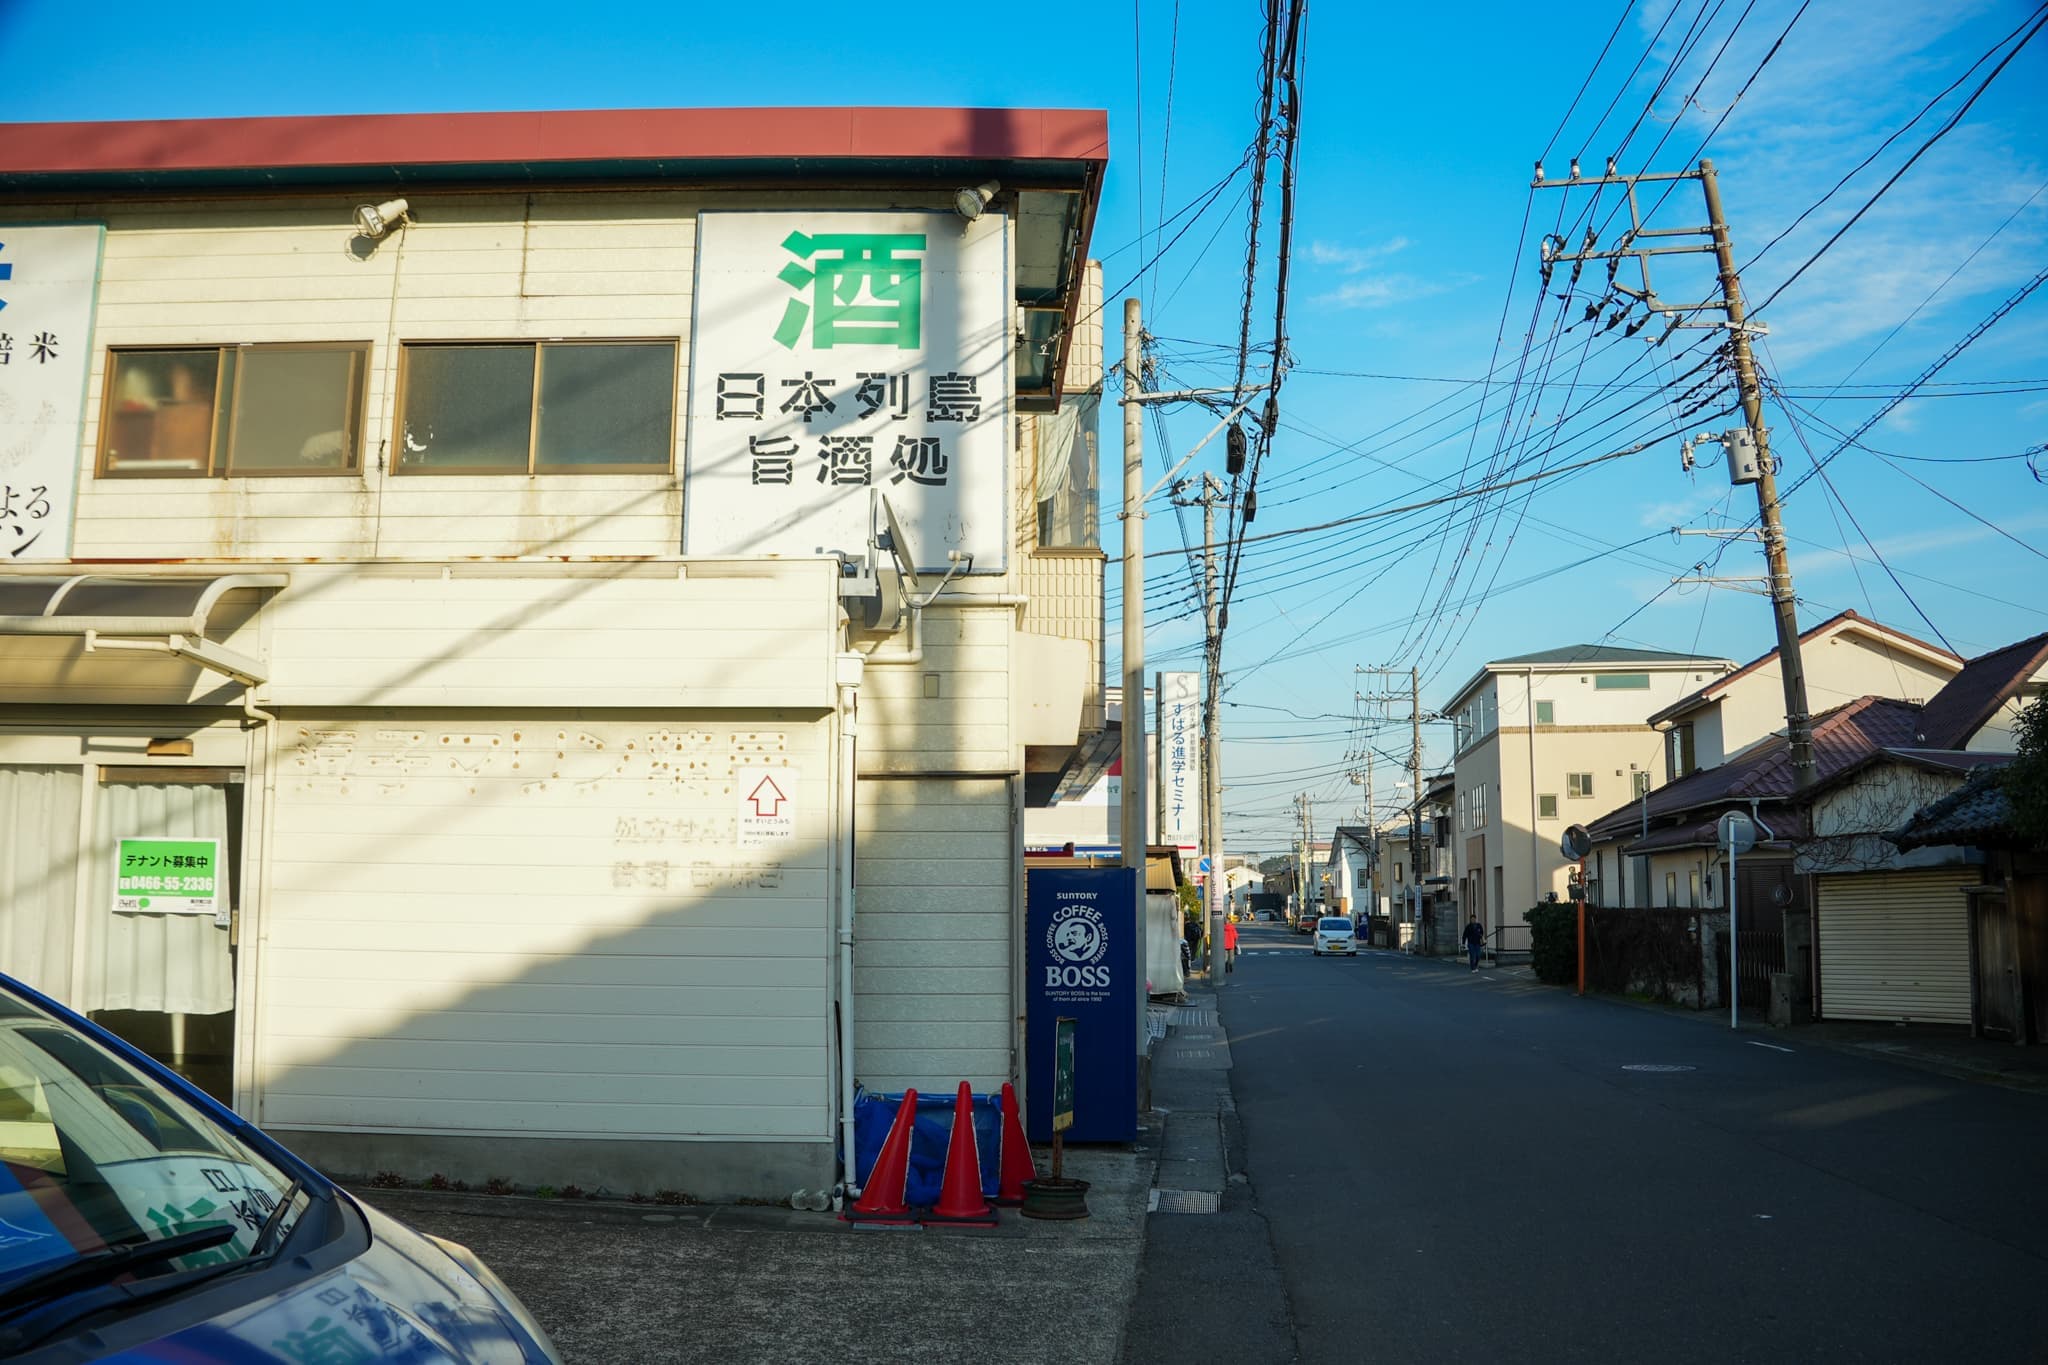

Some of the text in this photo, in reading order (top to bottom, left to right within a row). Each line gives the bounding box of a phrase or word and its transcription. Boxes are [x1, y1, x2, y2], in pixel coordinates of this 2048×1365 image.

[772, 230, 927, 350] 酒
[716, 371, 982, 423] 日本列島
[748, 434, 948, 486] 旨酒処
[0, 525, 43, 558] ン
[125, 855, 209, 869] テナント募集中
[131, 875, 214, 891] 0466-55-2336
[1056, 892, 1098, 900] SUNTORY
[1053, 904, 1103, 923] COFFEE
[1046, 922, 1057, 948] COFFEE
[1090, 942, 1108, 965] COFFEE
[1045, 966, 1111, 987] BOSS
